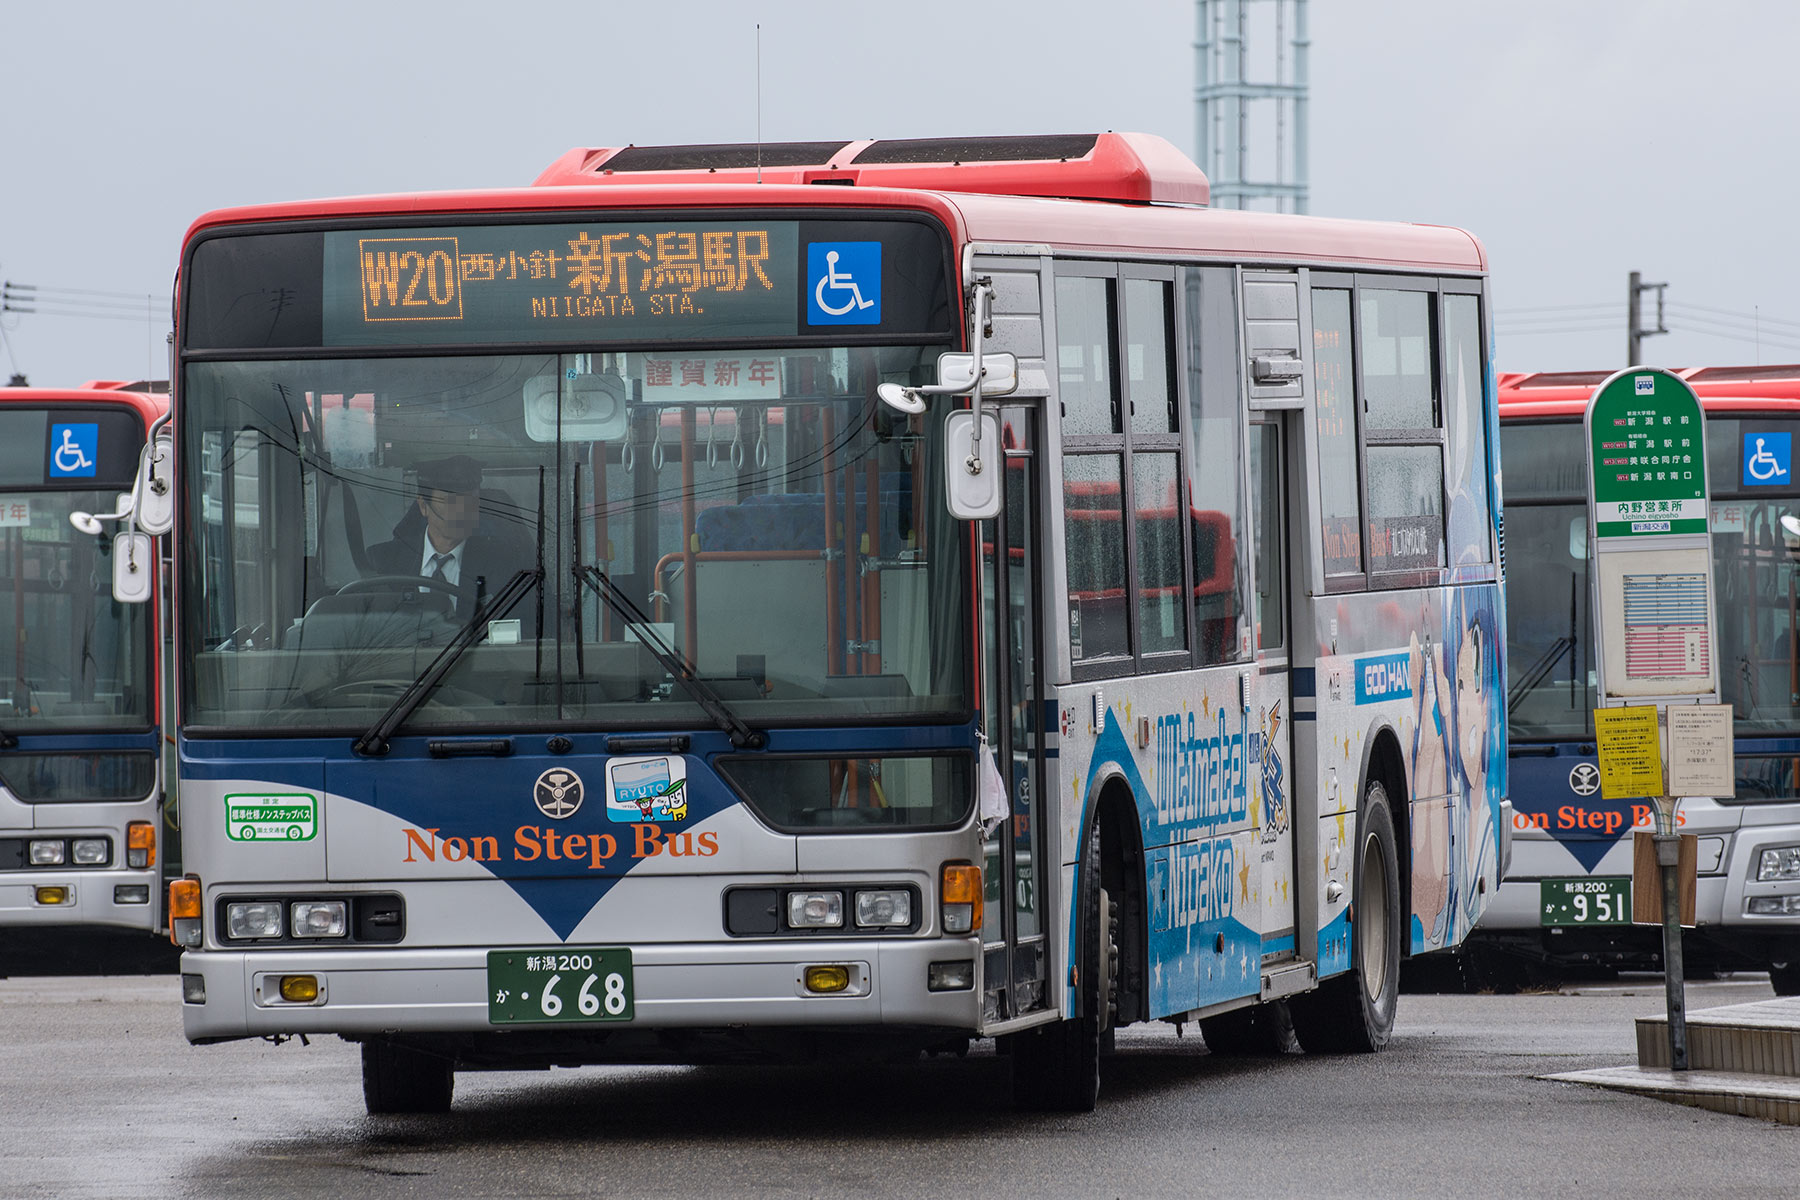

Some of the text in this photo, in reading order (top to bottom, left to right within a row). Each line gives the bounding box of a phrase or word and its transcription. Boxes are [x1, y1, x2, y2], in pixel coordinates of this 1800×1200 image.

[364, 231, 774, 306] W20 西小針 新潟駅
[532, 292, 705, 319] NIIGATA STA.
[645, 357, 777, 390] 謹賀新年
[1627, 415, 1689, 426] 新潟駅前
[1628, 438, 1690, 449] 新潟駅前
[1630, 471, 1692, 482] 新潟駅南口
[1618, 500, 1683, 514] 内野営業所
[1622, 512, 1647, 521] Uchino
[1633, 522, 1670, 531] 新潟交通
[620, 784, 665, 799] RYUTO
[231, 809, 312, 820] 標準仕様ノンステップバス
[1513, 804, 1687, 835] on Step Bs
[402, 822, 721, 870] Non Step Bus
[1545, 903, 1556, 914] か
[495, 988, 510, 1005] か
